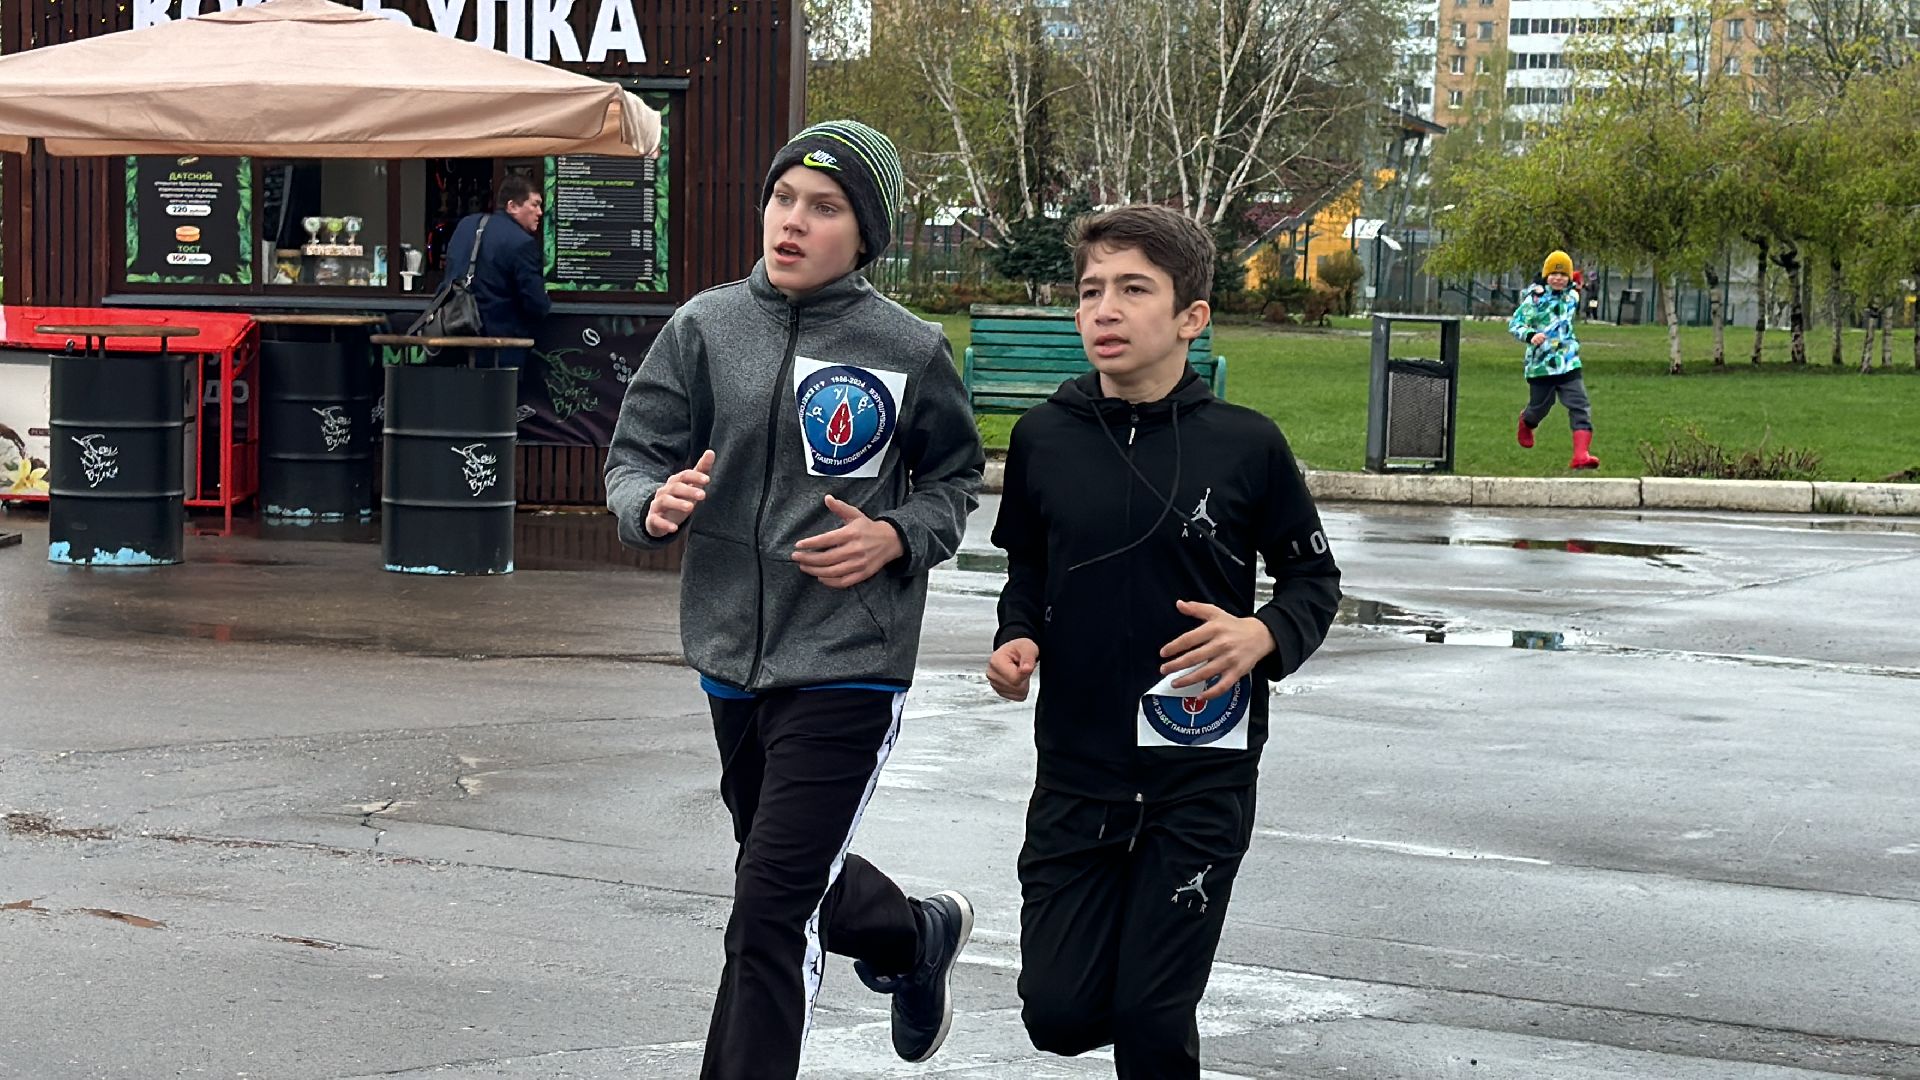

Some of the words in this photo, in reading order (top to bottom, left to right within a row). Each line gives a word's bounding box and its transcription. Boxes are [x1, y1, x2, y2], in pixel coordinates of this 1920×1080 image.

[811, 150, 837, 164] NIKE
[169, 171, 213, 181] ДАТСКИЙ
[177, 245, 201, 253] ТОСТ
[814, 451, 843, 466] ПАМЯТИ
[843, 444, 872, 465] ПОДВИГА
[1181, 527, 1217, 539] AR
[1154, 705, 1173, 726] ЗАБЕГ
[1170, 722, 1201, 735] ПАМЯТИ
[1201, 711, 1233, 735] ПОДВИГА
[1227, 679, 1241, 711] ЧЕРНОБ
[1170, 893, 1208, 914] AIR
